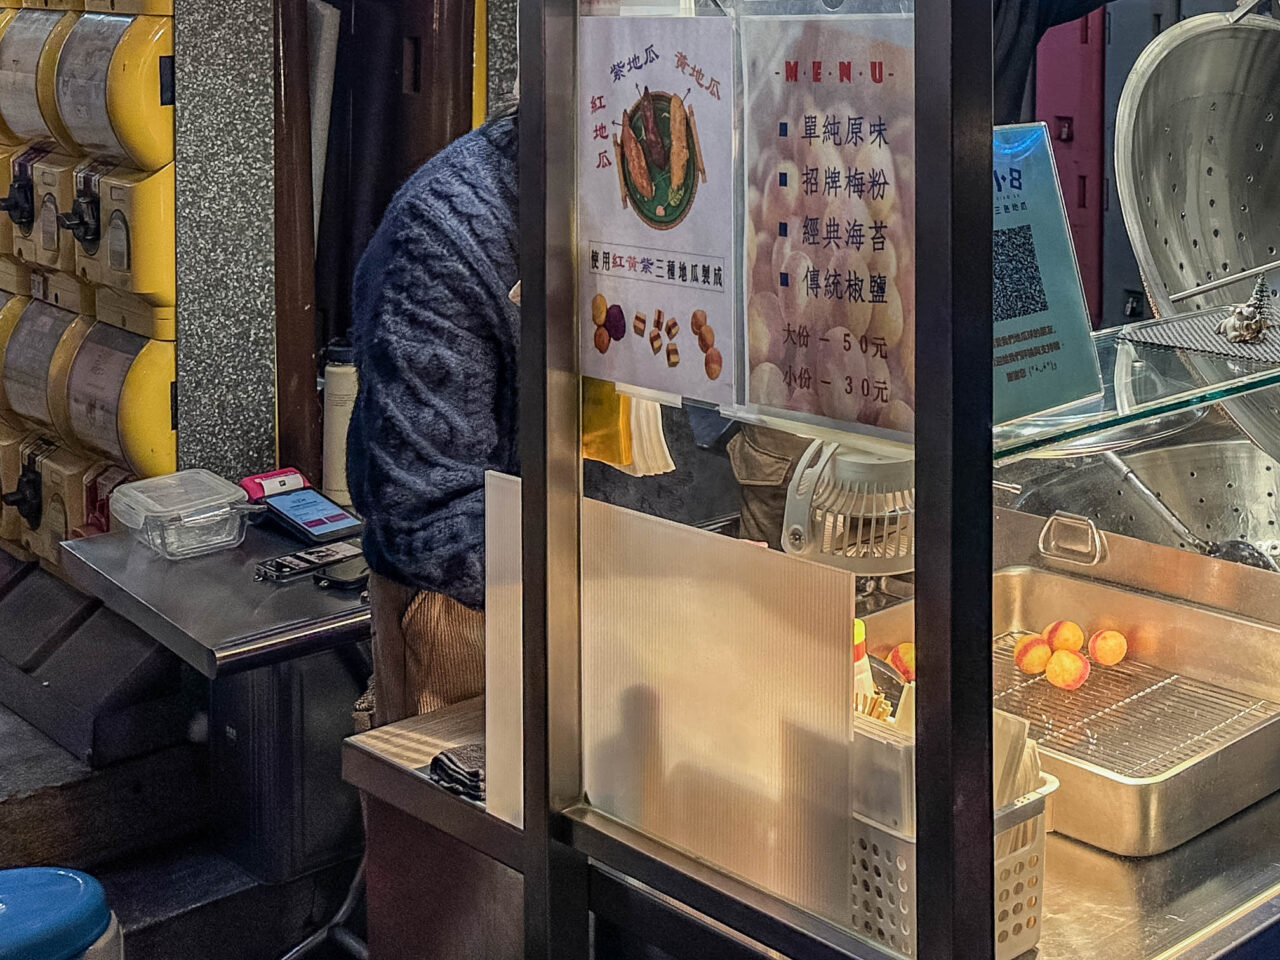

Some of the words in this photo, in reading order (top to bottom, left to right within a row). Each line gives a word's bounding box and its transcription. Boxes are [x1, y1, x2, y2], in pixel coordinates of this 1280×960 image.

[610, 44, 660, 83] 紫地瓜
[674, 50, 721, 100] 黃地瓜
[589, 94, 613, 169] 紅地瓜
[801, 113, 889, 147] 單純原味
[801, 166, 889, 201] 招牌梅粉
[801, 216, 889, 253] 經典海苔
[591, 249, 723, 287] 使用紅黃紫三種地瓜製成
[802, 265, 889, 305] 傳統椒鹽
